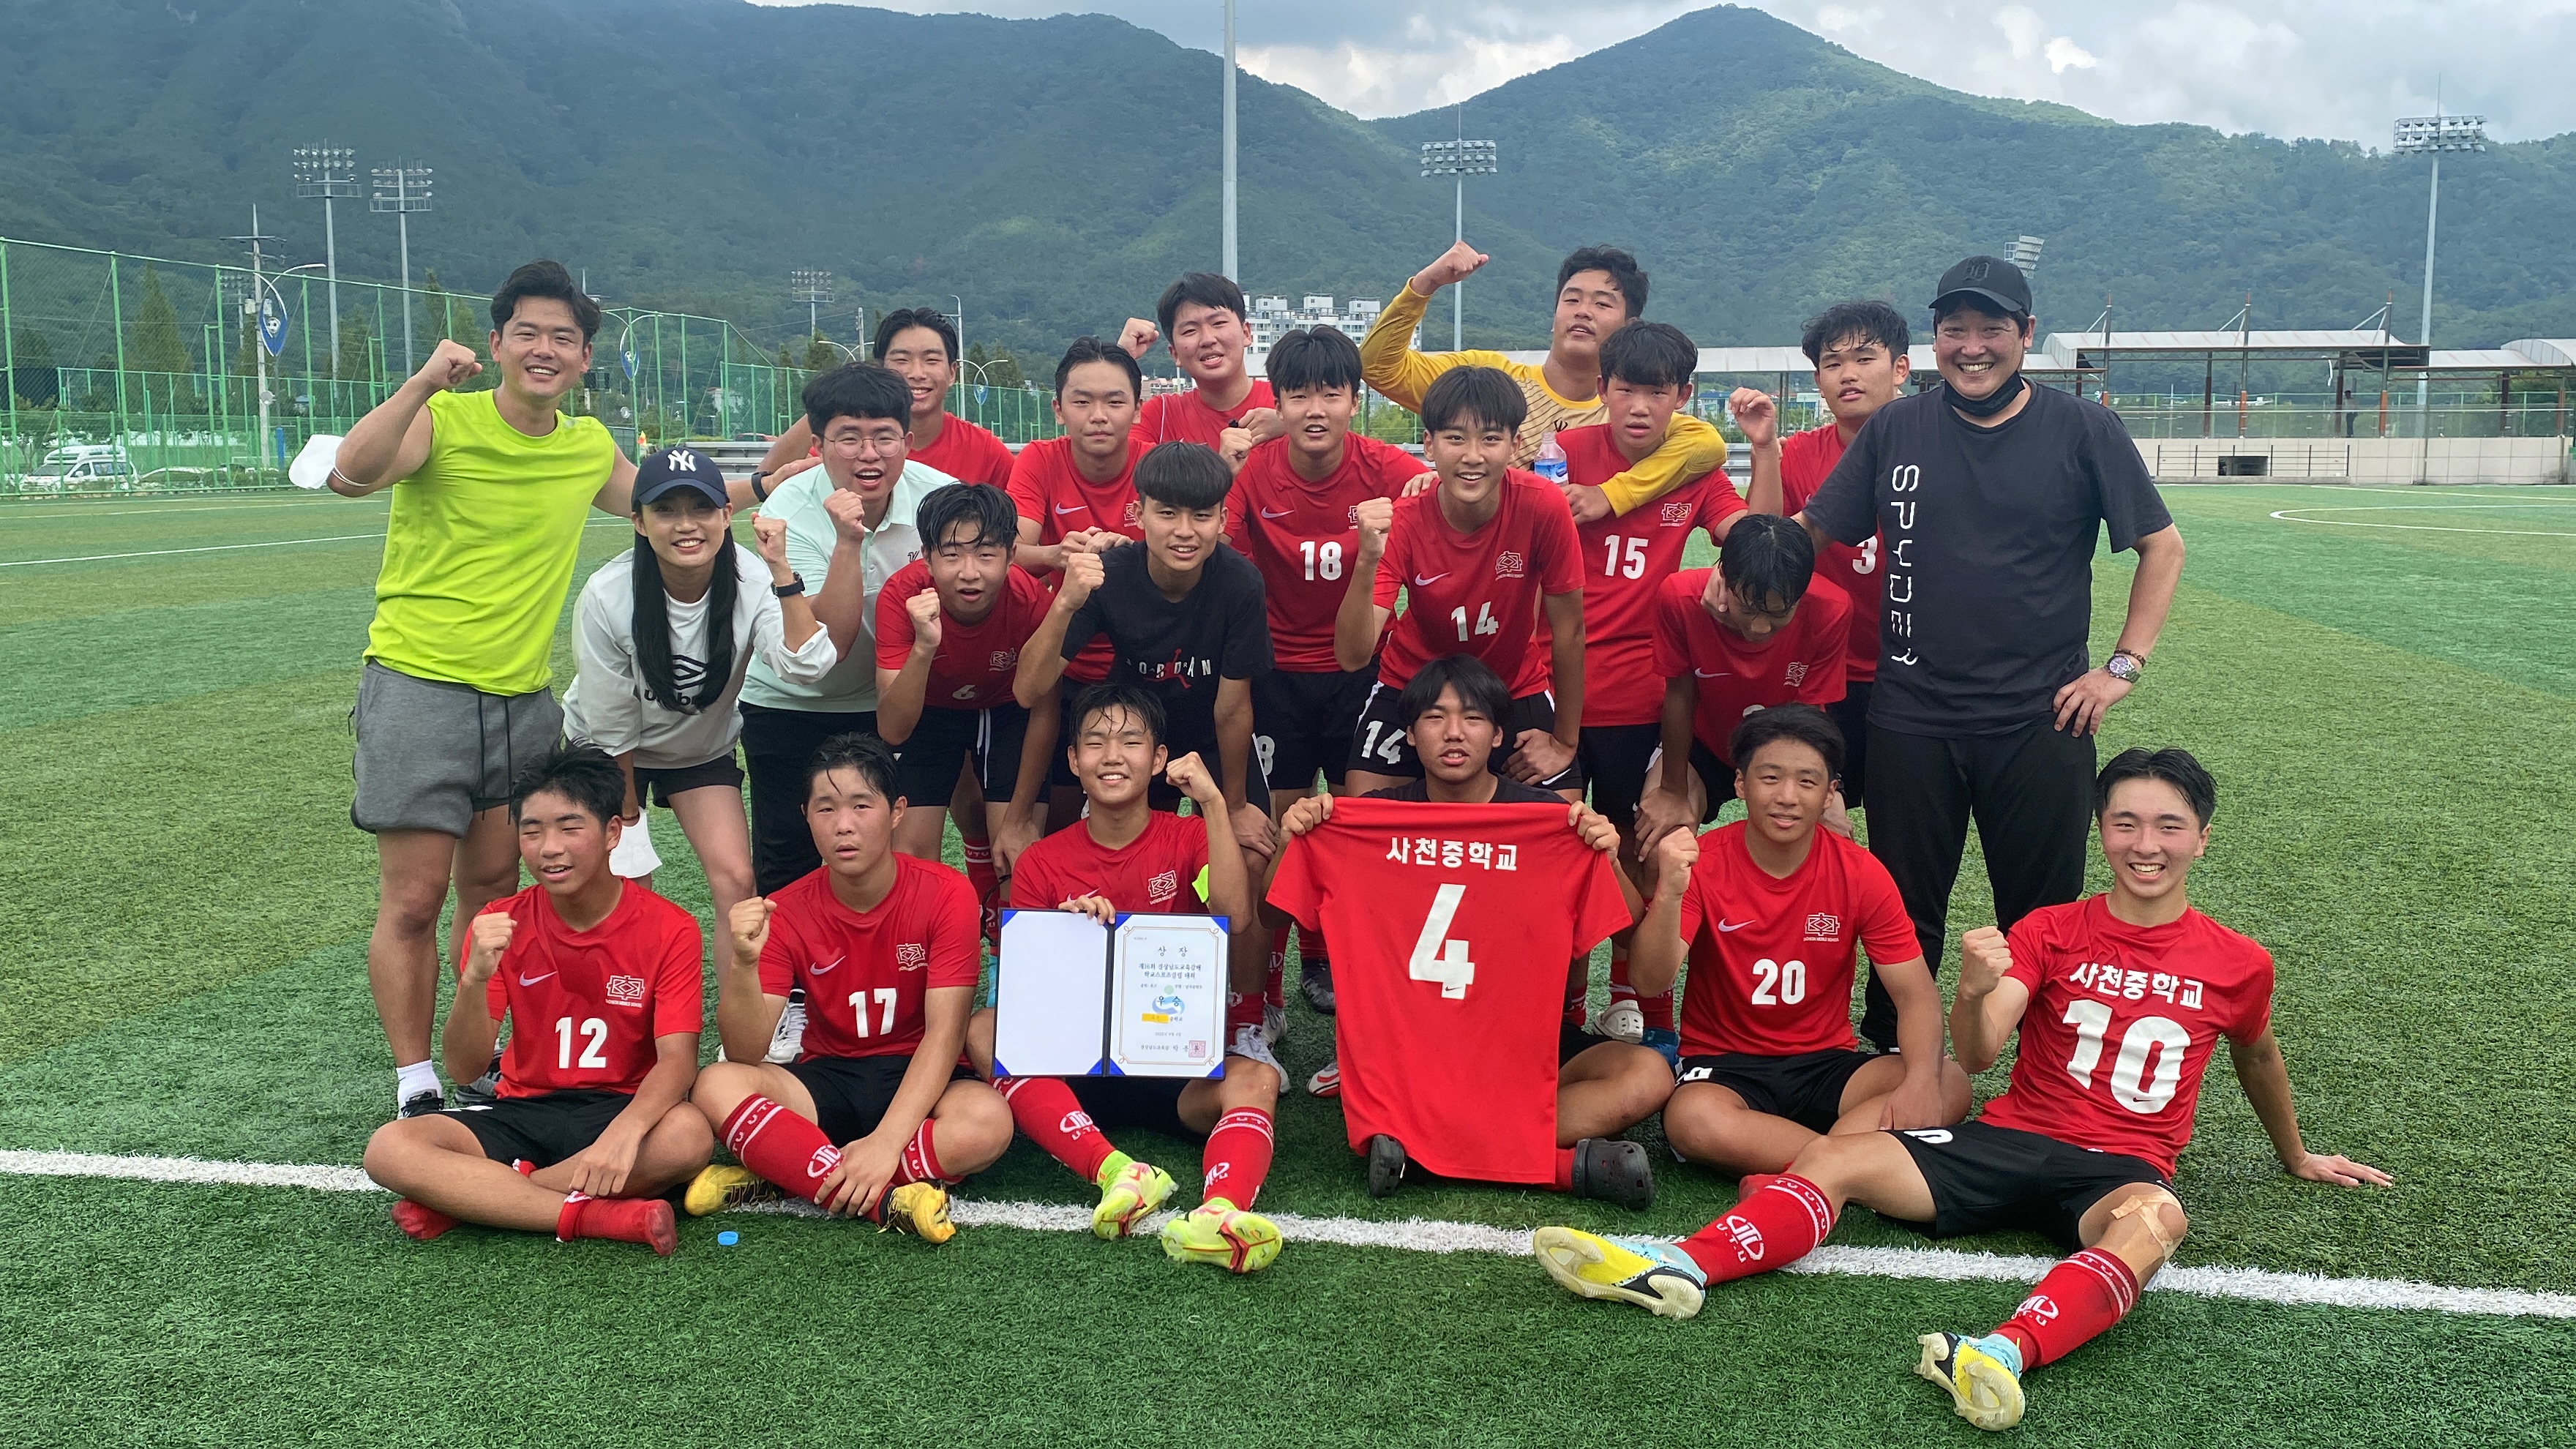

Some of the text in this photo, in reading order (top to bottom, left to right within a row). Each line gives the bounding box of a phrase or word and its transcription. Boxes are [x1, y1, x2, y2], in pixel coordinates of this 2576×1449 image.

[1300, 542, 1341, 580] 18
[1605, 535, 1648, 579] 15
[1451, 602, 1498, 641] 14
[953, 684, 976, 700] 6
[1361, 720, 1406, 764] 14
[1386, 836, 1516, 871] 사천중학교
[1409, 883, 1475, 1000] 4
[1752, 959, 1805, 1005] 20
[2069, 962, 2204, 1011] 사천중학교
[849, 988, 897, 1038] 17
[555, 1016, 607, 1069] 12
[2062, 999, 2191, 1114] 10
